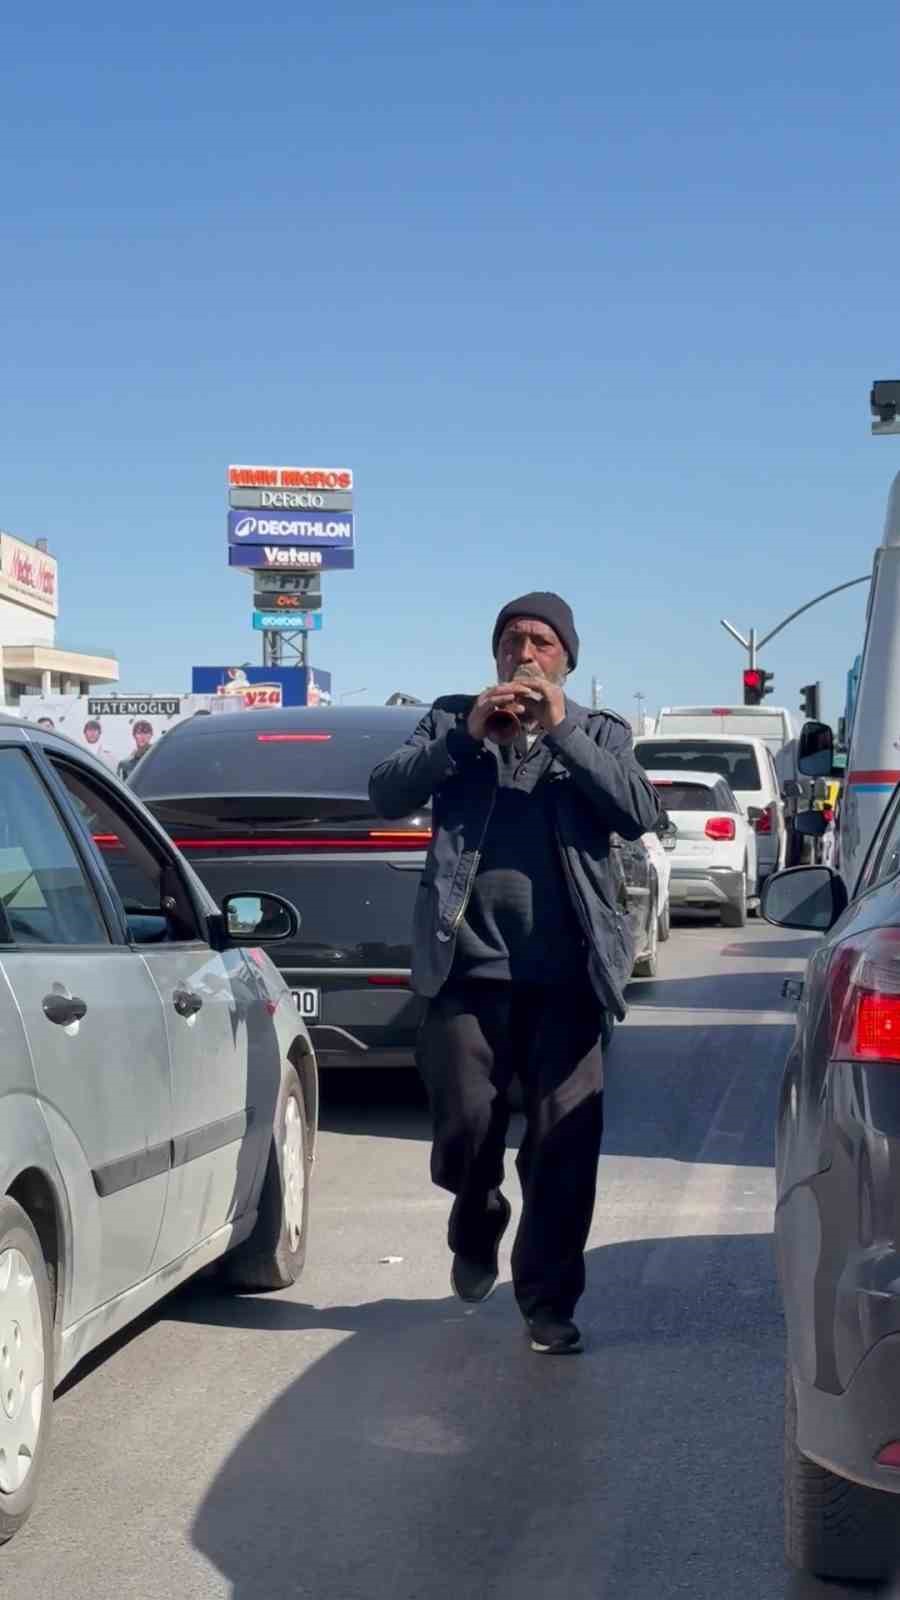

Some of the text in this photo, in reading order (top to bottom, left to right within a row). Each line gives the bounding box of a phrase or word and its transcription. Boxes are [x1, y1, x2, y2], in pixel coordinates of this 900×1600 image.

[281, 470, 351, 488] MIGROS
[261, 491, 324, 507] DeFacto
[258, 519, 351, 537] DECATHLON
[264, 546, 322, 563] Vatan
[245, 690, 281, 705] yza
